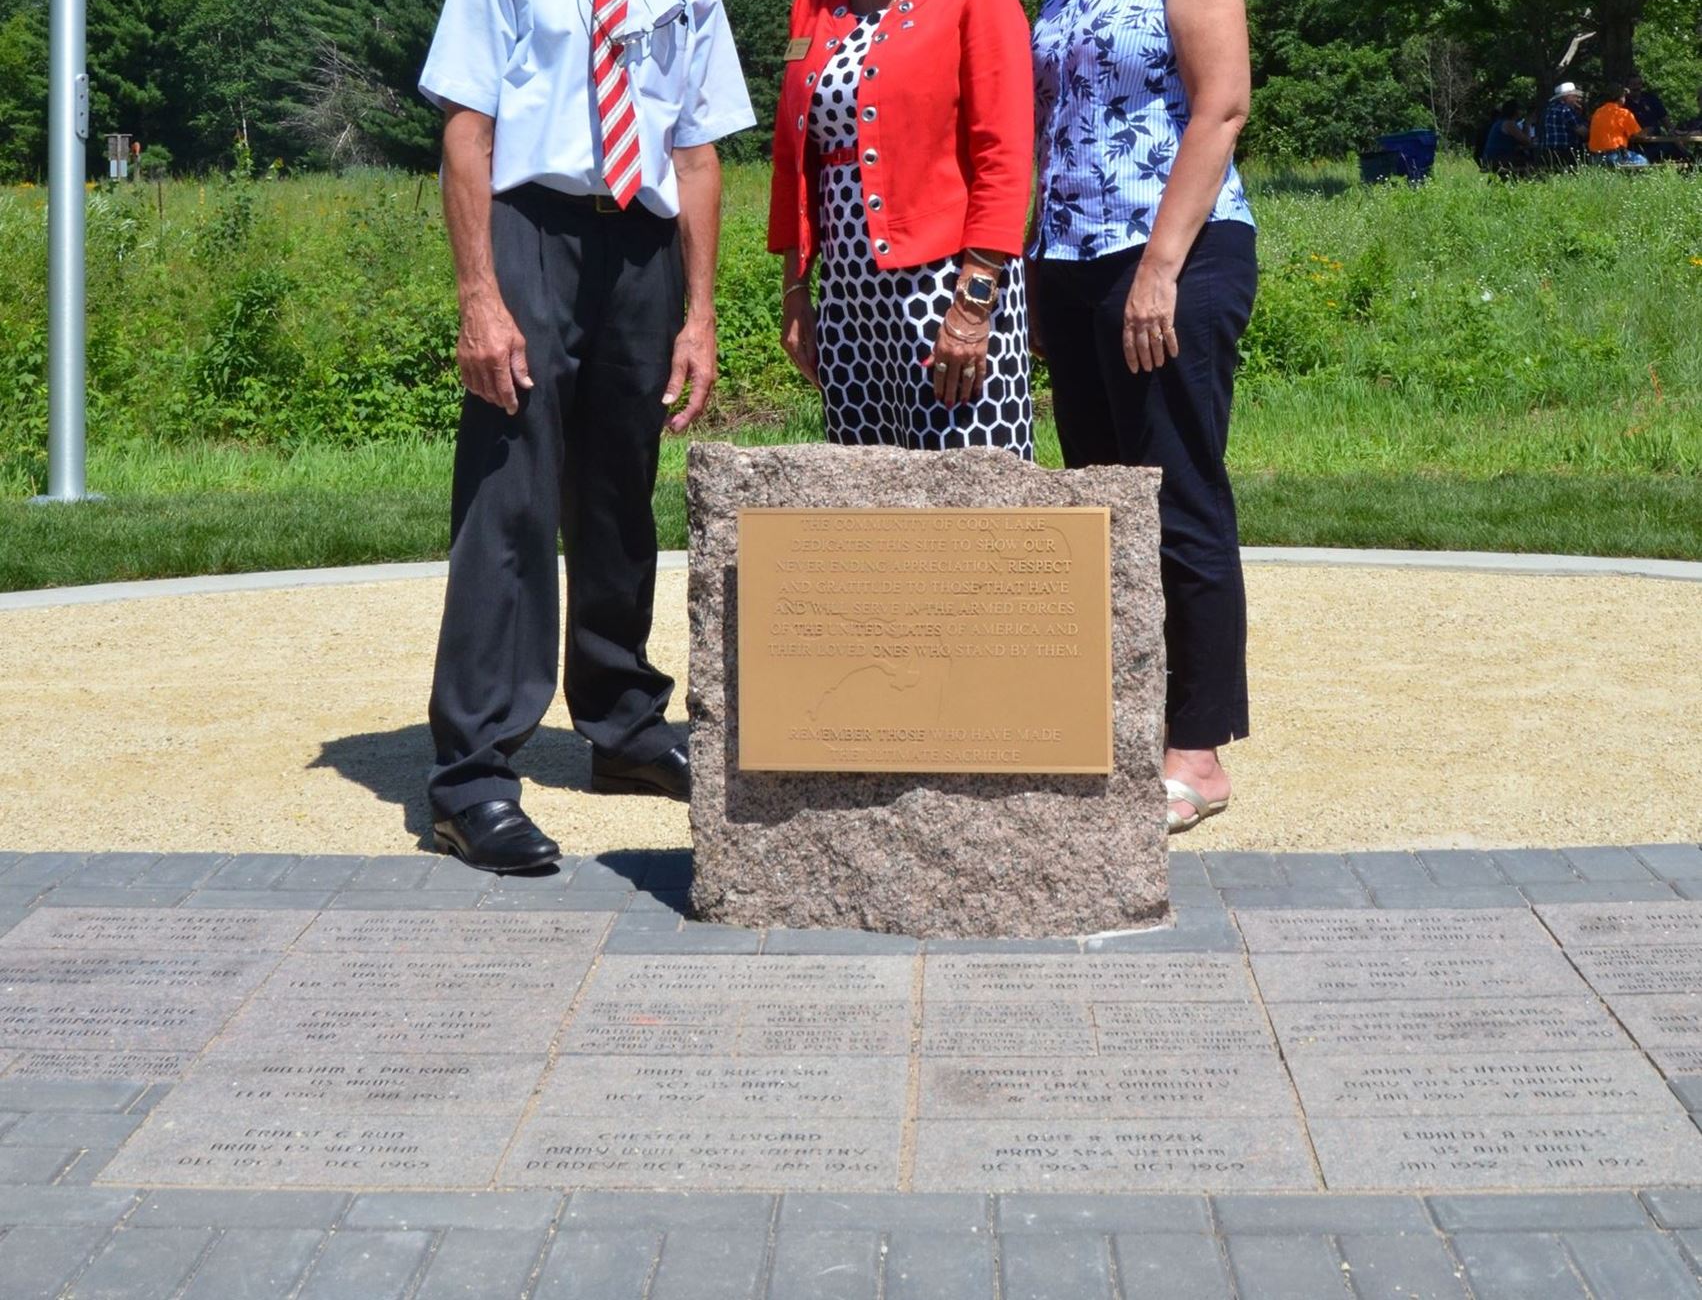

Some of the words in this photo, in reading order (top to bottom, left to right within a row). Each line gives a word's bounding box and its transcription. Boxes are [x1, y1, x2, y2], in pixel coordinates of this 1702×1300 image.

[801, 518, 829, 532] THE
[834, 518, 927, 532] COMMUNITY
[934, 518, 953, 532] OF
[957, 518, 999, 532] COON
[1004, 518, 1046, 532] LAKE
[791, 539, 872, 553] DEDICATES
[876, 539, 911, 553] THIS
[914, 539, 948, 553] SITE
[952, 539, 972, 553] TO
[976, 539, 1018, 553] SHOW
[1023, 539, 1056, 553] OUR
[775, 560, 825, 574] NEVER
[829, 560, 887, 574] ENDING
[1008, 560, 1073, 574] RESPECT
[779, 581, 812, 595] AND
[815, 581, 902, 595] GRATITUDE
[906, 581, 928, 595] TO
[931, 581, 981, 595] THOSE
[984, 581, 1024, 595] THAT
[1027, 581, 1070, 595] HAVE
[773, 602, 809, 616] AND
[811, 602, 849, 616] WILL
[853, 602, 900, 616] SERVE
[904, 602, 921, 616] IN
[926, 602, 955, 616] THE
[959, 602, 1014, 616] ARMED
[1018, 602, 1076, 616] FORCES
[770, 623, 791, 637] OF
[793, 623, 824, 637] THE
[827, 623, 885, 637] UNITED
[887, 623, 942, 637] STATES
[946, 623, 967, 637] OF
[973, 623, 1041, 637] AMERICA
[1046, 623, 1080, 637] AND
[768, 644, 812, 658] THEIR
[816, 644, 866, 658] LOVED
[871, 644, 911, 658] ONES
[914, 644, 952, 658] WHO
[956, 644, 1006, 658] STAND
[1010, 644, 1028, 658] BY
[789, 728, 872, 743] REMEMBER
[876, 728, 926, 743] THOSE
[931, 728, 968, 743] WHO
[971, 728, 1012, 743] HAVE
[1016, 728, 1062, 743] MADE
[829, 749, 860, 764] THE
[865, 749, 940, 764] ULTIMATE
[943, 749, 1023, 764] SACRIFICE
